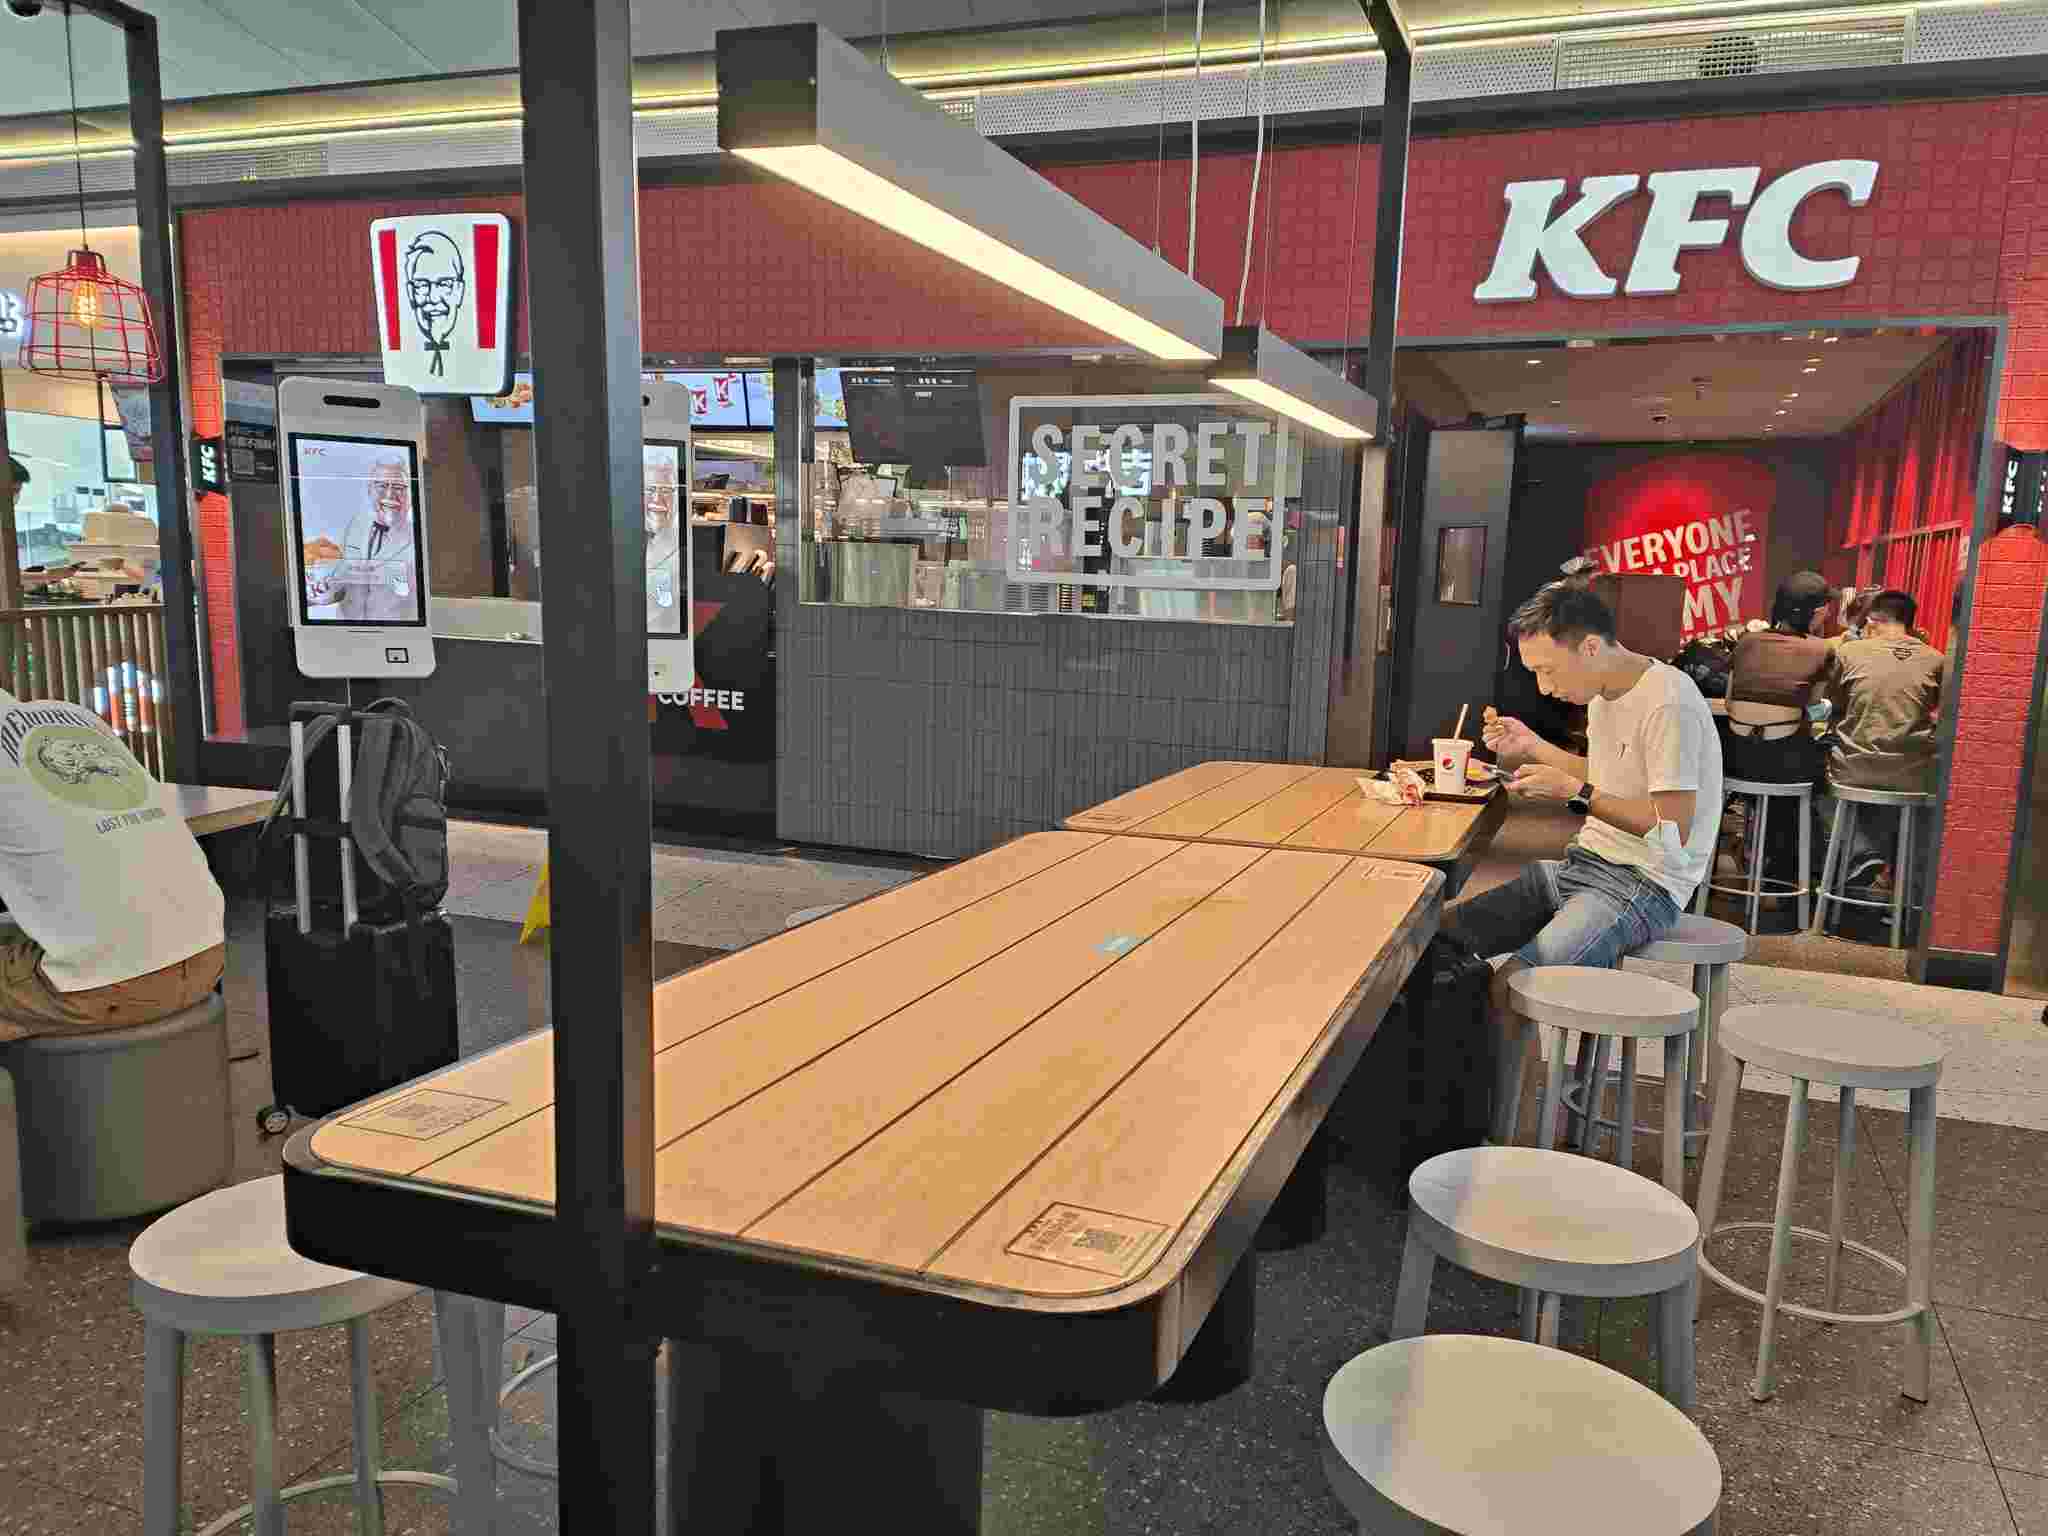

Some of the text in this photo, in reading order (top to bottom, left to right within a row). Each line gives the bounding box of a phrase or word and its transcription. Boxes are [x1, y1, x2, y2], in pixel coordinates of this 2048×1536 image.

[1473, 159, 1879, 303] KFC
[200, 444, 216, 482] KFC
[1031, 422, 1271, 488] SECRET
[2002, 460, 2018, 513] KFC
[1031, 495, 1267, 560] RECIPE
[1682, 576, 1743, 632] MY
[657, 688, 745, 710] COFFEE
